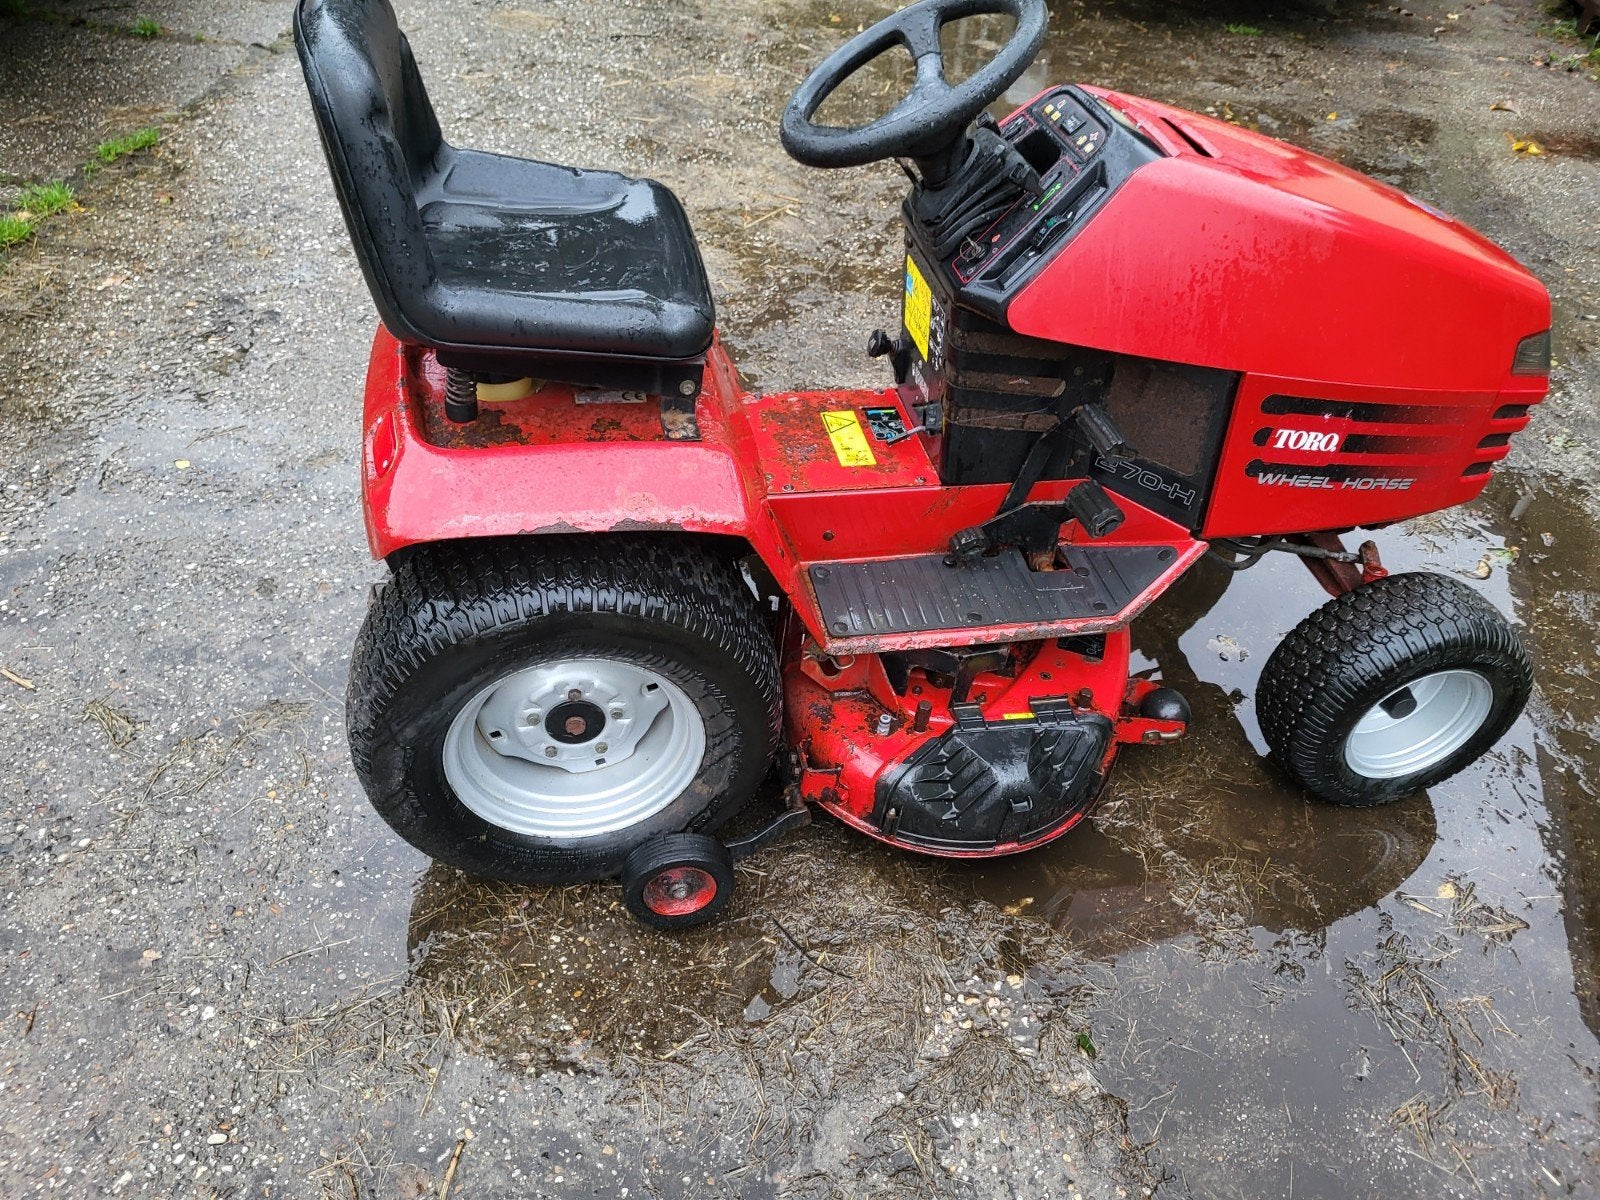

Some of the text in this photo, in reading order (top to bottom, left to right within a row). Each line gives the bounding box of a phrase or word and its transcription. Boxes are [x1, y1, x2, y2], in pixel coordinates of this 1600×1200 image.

[1273, 429, 1339, 452] TORO
[1257, 472, 1416, 490] WHEEL HORSE
